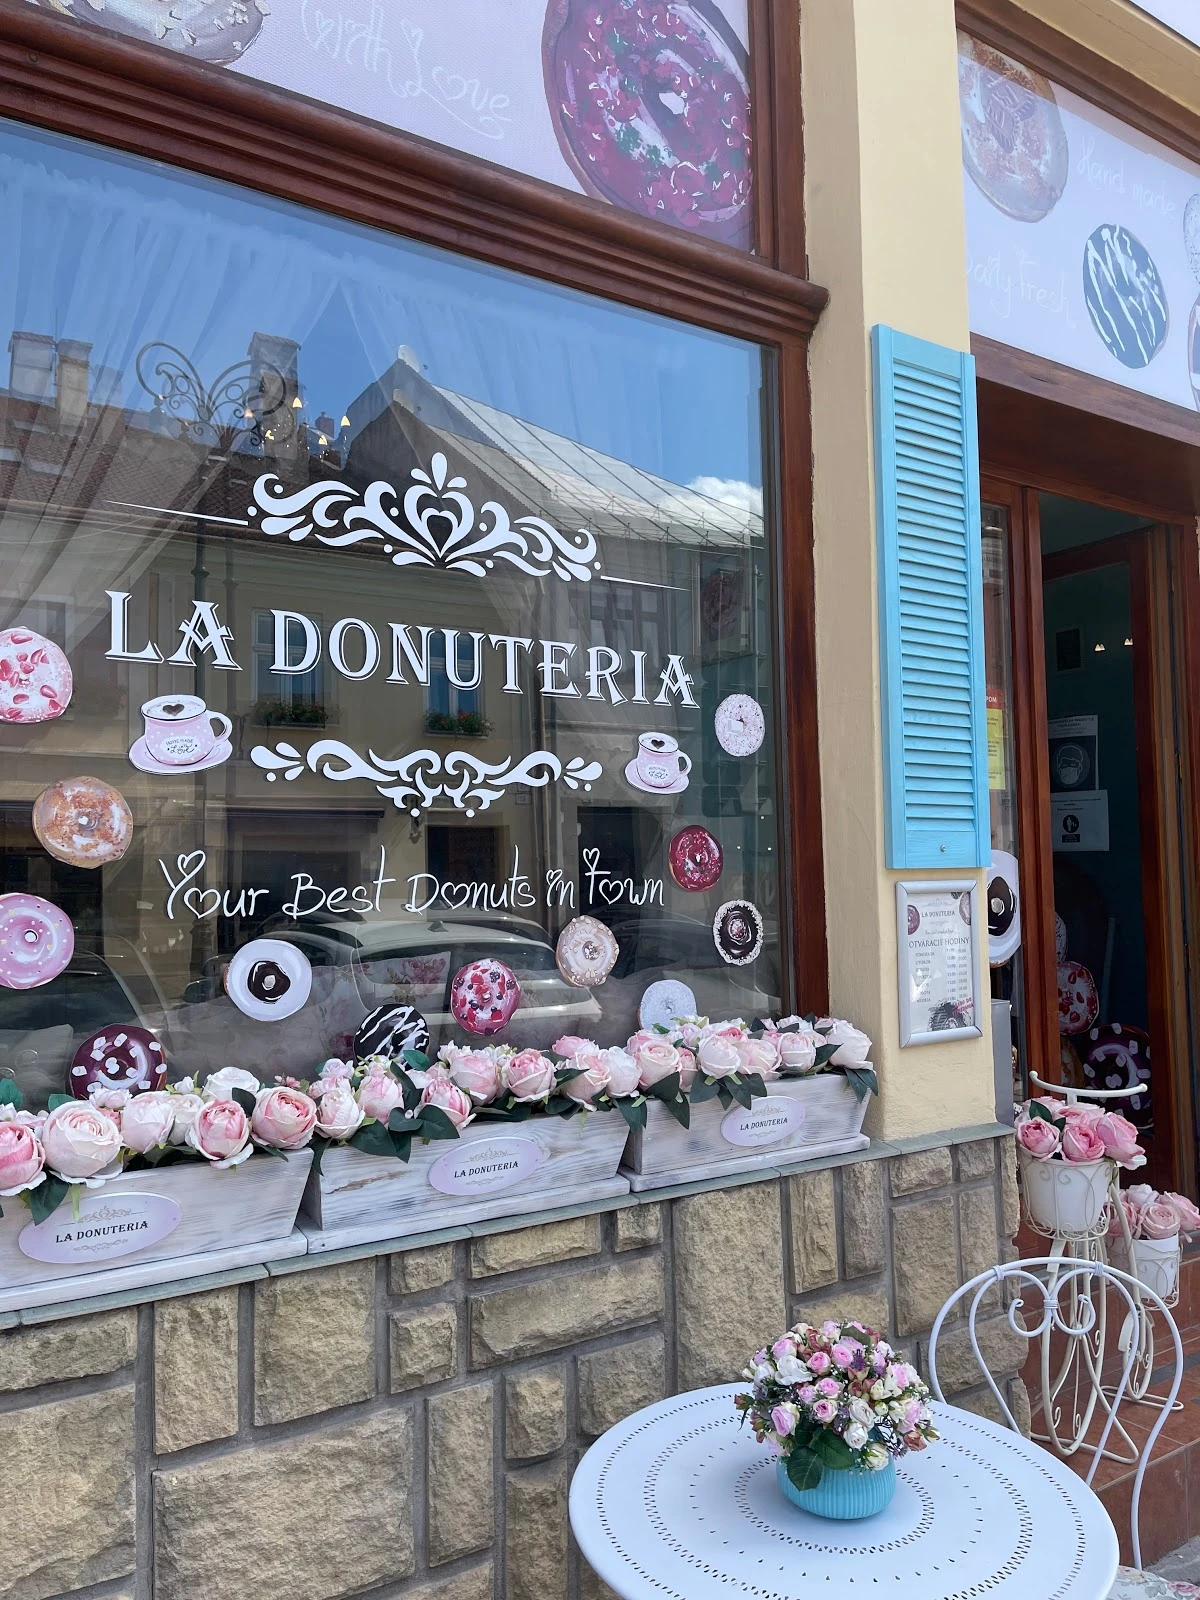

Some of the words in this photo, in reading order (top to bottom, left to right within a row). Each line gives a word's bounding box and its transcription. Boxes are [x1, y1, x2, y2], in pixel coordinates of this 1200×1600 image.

[104, 590, 243, 671] LA
[269, 608, 700, 710] DONUTERIA
[158, 850, 270, 920] Your
[282, 845, 396, 919] Best
[404, 845, 536, 914] Donuts
[545, 868, 576, 909] in
[740, 1123, 749, 1131] LA
[750, 1117, 788, 1130] DONUTERIA
[453, 1169, 467, 1179] LA
[468, 1160, 519, 1177] DONUTERIA
[55, 1233, 73, 1244] LA
[76, 1220, 150, 1240] DONUTERIA
